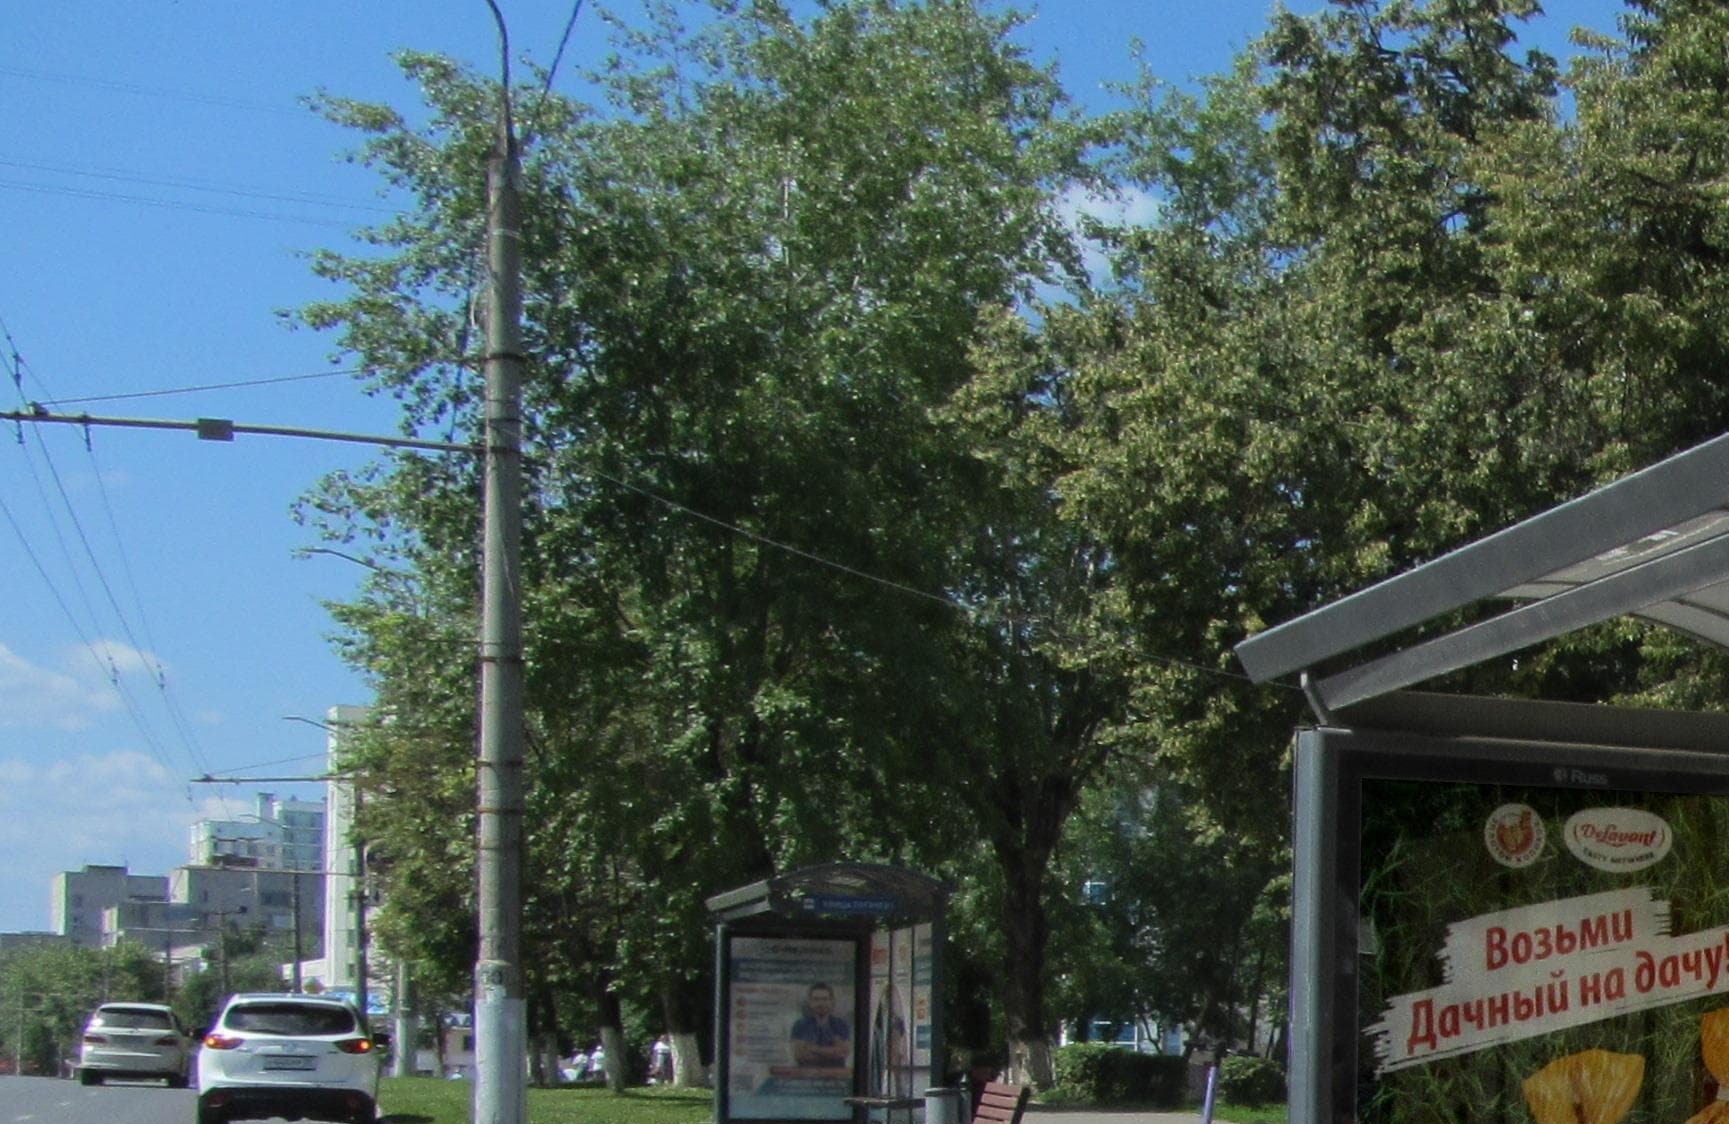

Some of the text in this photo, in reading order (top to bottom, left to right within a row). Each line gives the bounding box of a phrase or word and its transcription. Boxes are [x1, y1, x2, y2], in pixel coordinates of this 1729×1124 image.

[1485, 909, 1634, 972] Возьми
[1406, 971, 1570, 1056] Дачный
[1580, 967, 1625, 1008] на
